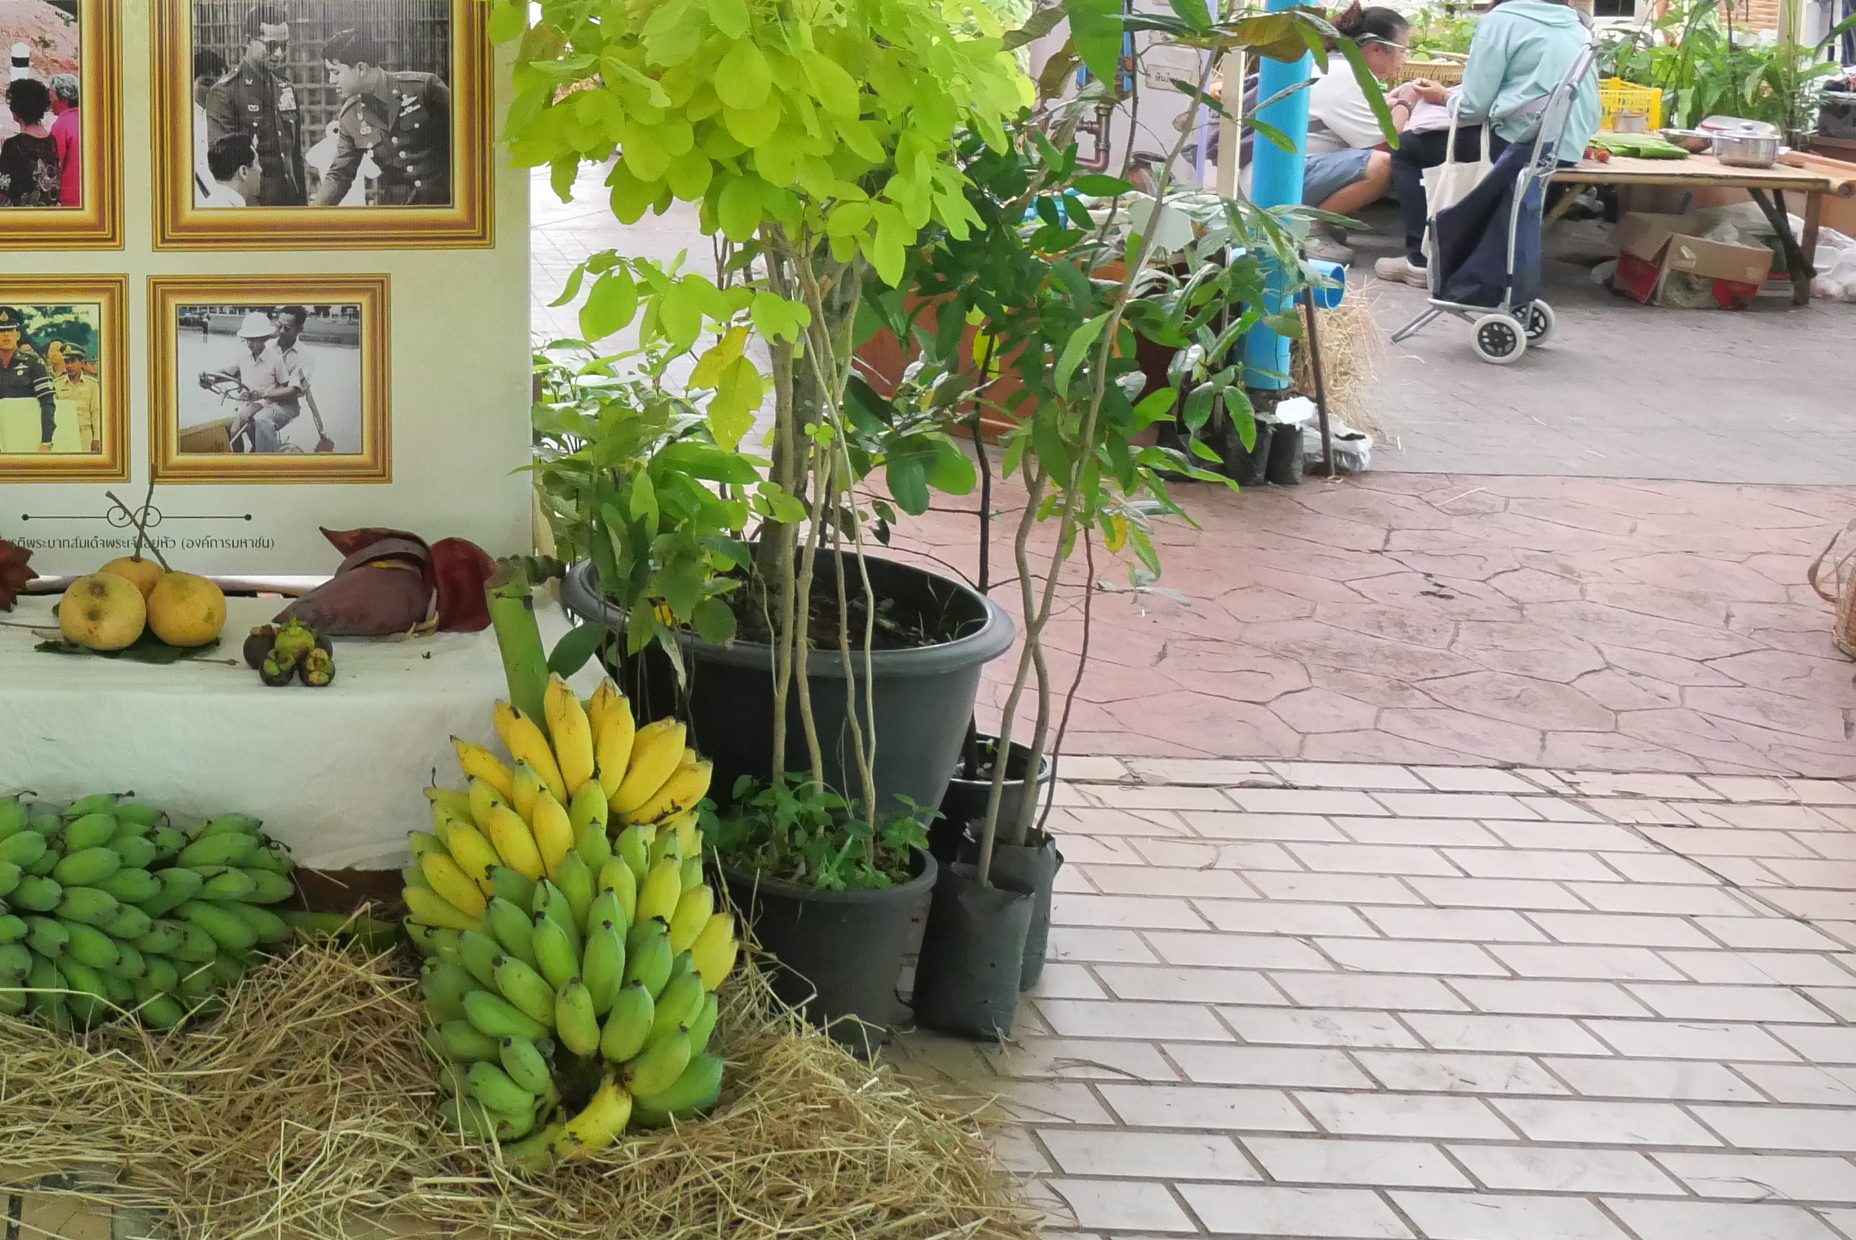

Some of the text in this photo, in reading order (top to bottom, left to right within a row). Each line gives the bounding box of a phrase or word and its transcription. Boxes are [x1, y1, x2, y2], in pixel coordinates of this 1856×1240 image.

[181, 535, 275, 551] (องค์การมหาชน)
